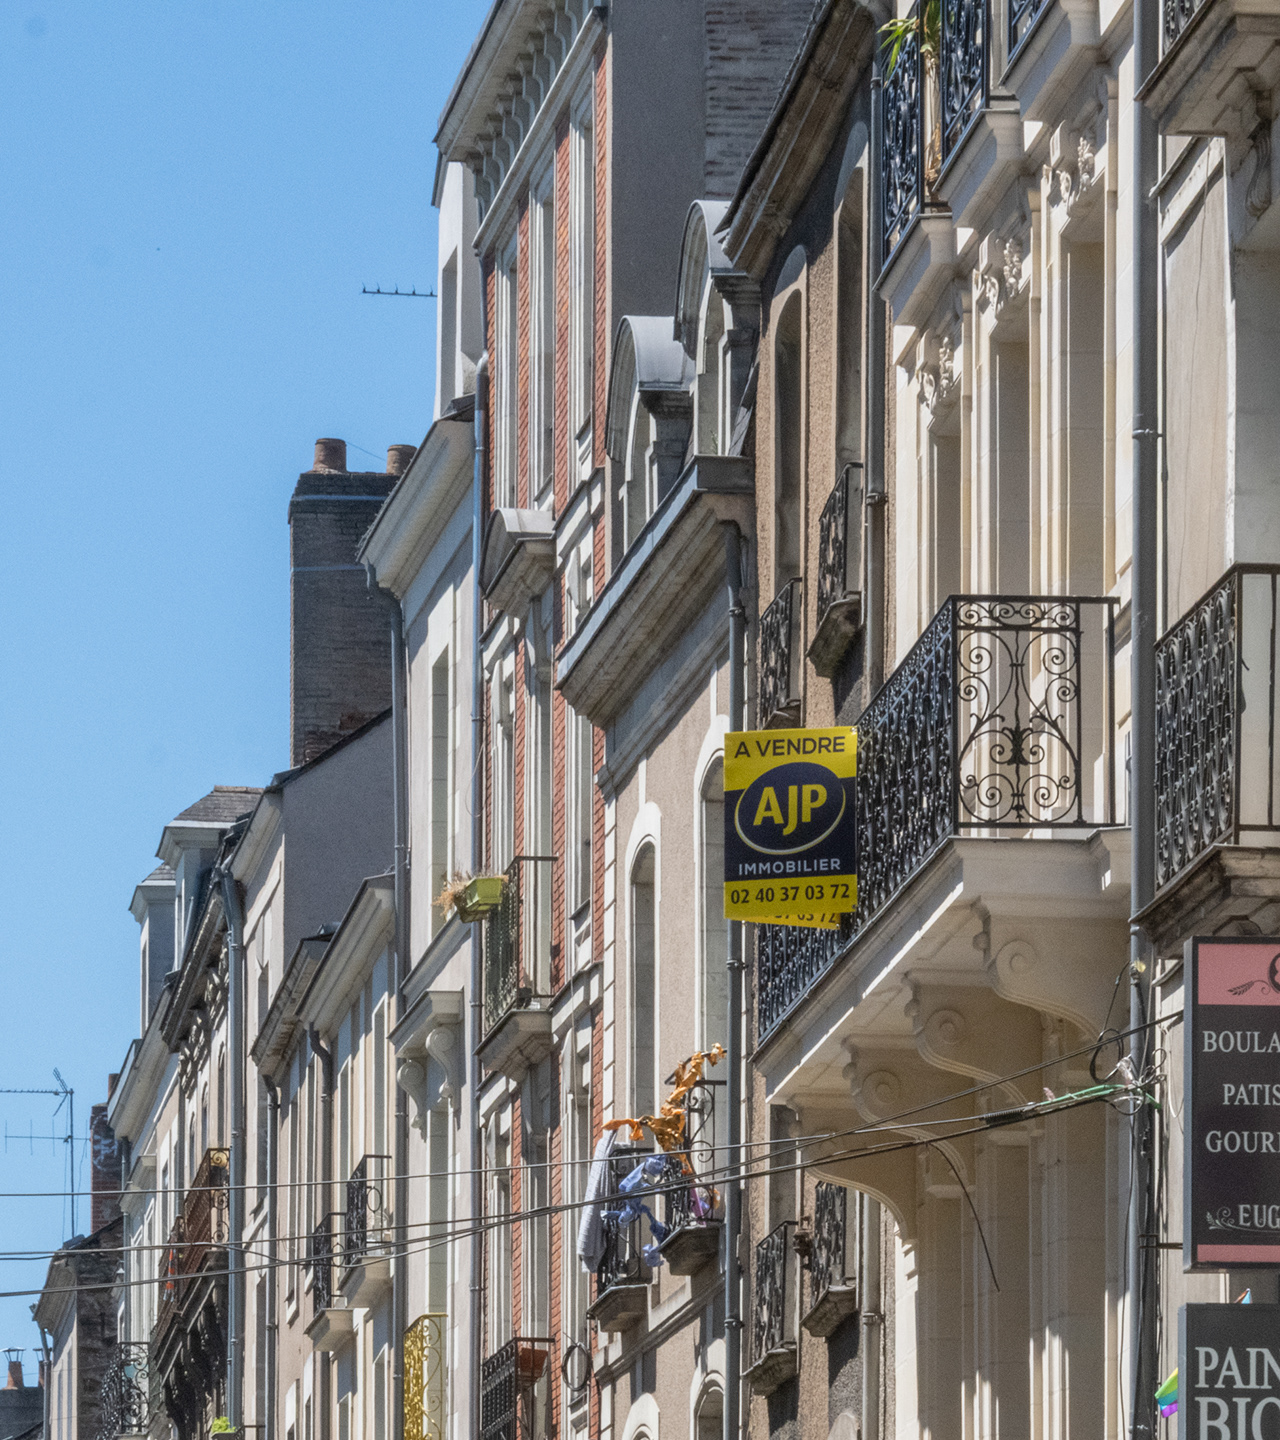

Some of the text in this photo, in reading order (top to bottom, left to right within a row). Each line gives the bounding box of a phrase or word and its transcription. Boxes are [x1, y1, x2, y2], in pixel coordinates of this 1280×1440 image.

[734, 736, 846, 758] A VENDRE
[753, 784, 828, 836] AJP
[738, 858, 841, 876] IMMOBILIER
[731, 884, 850, 905] 02 40 37 03 72
